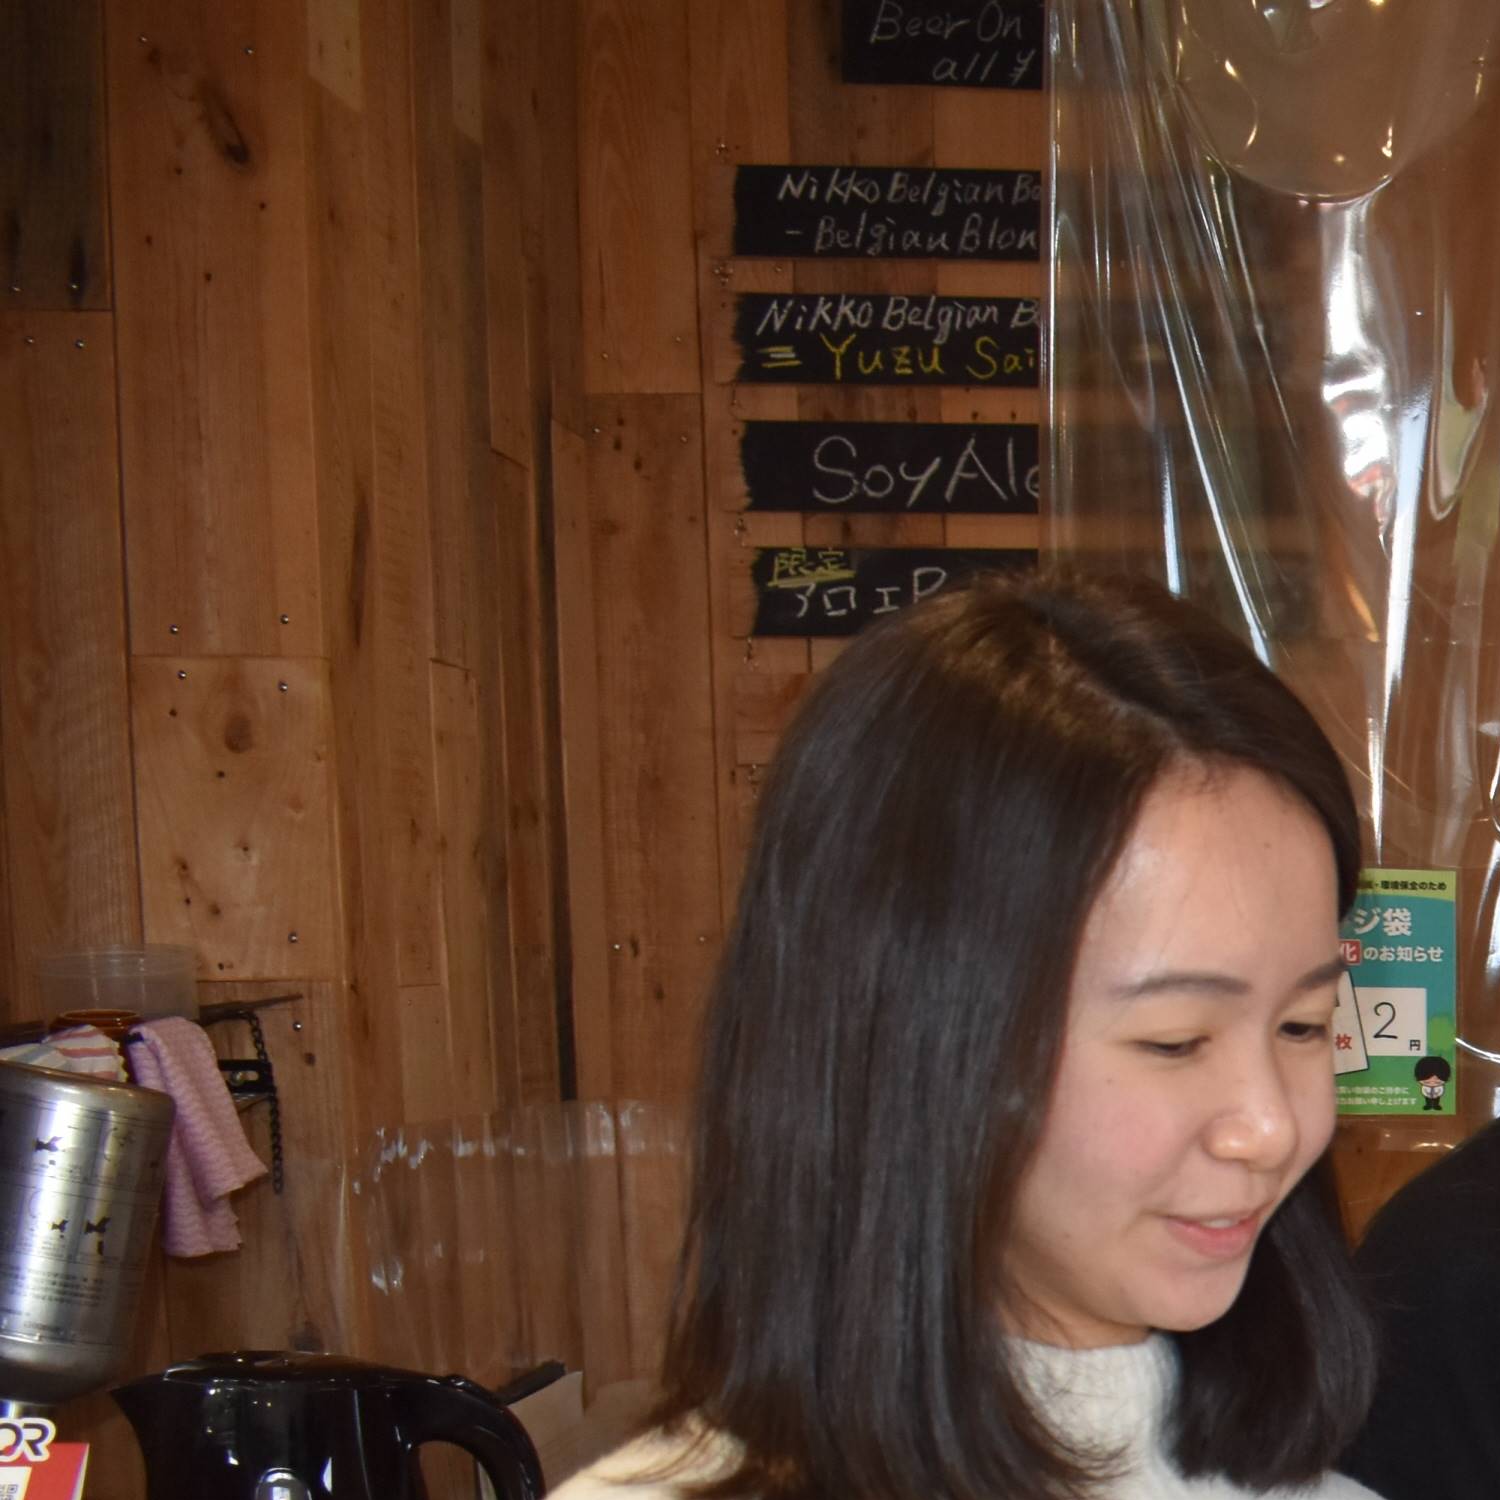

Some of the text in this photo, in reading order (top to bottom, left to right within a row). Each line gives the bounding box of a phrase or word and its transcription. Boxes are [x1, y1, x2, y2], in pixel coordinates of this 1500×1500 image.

[932, 51, 999, 81] all
[777, 168, 881, 204] Nikko
[887, 170, 1004, 216] Belgian
[814, 210, 1039, 256] Belgian Blon
[755, 295, 874, 336] Nikko
[882, 296, 1000, 345] Belgian
[820, 333, 945, 381] Yuzu
[1359, 879, 1447, 891] ・環境保全のため
[1335, 1033, 1353, 1051] 枚
[1373, 1001, 1421, 1051] 2 円
